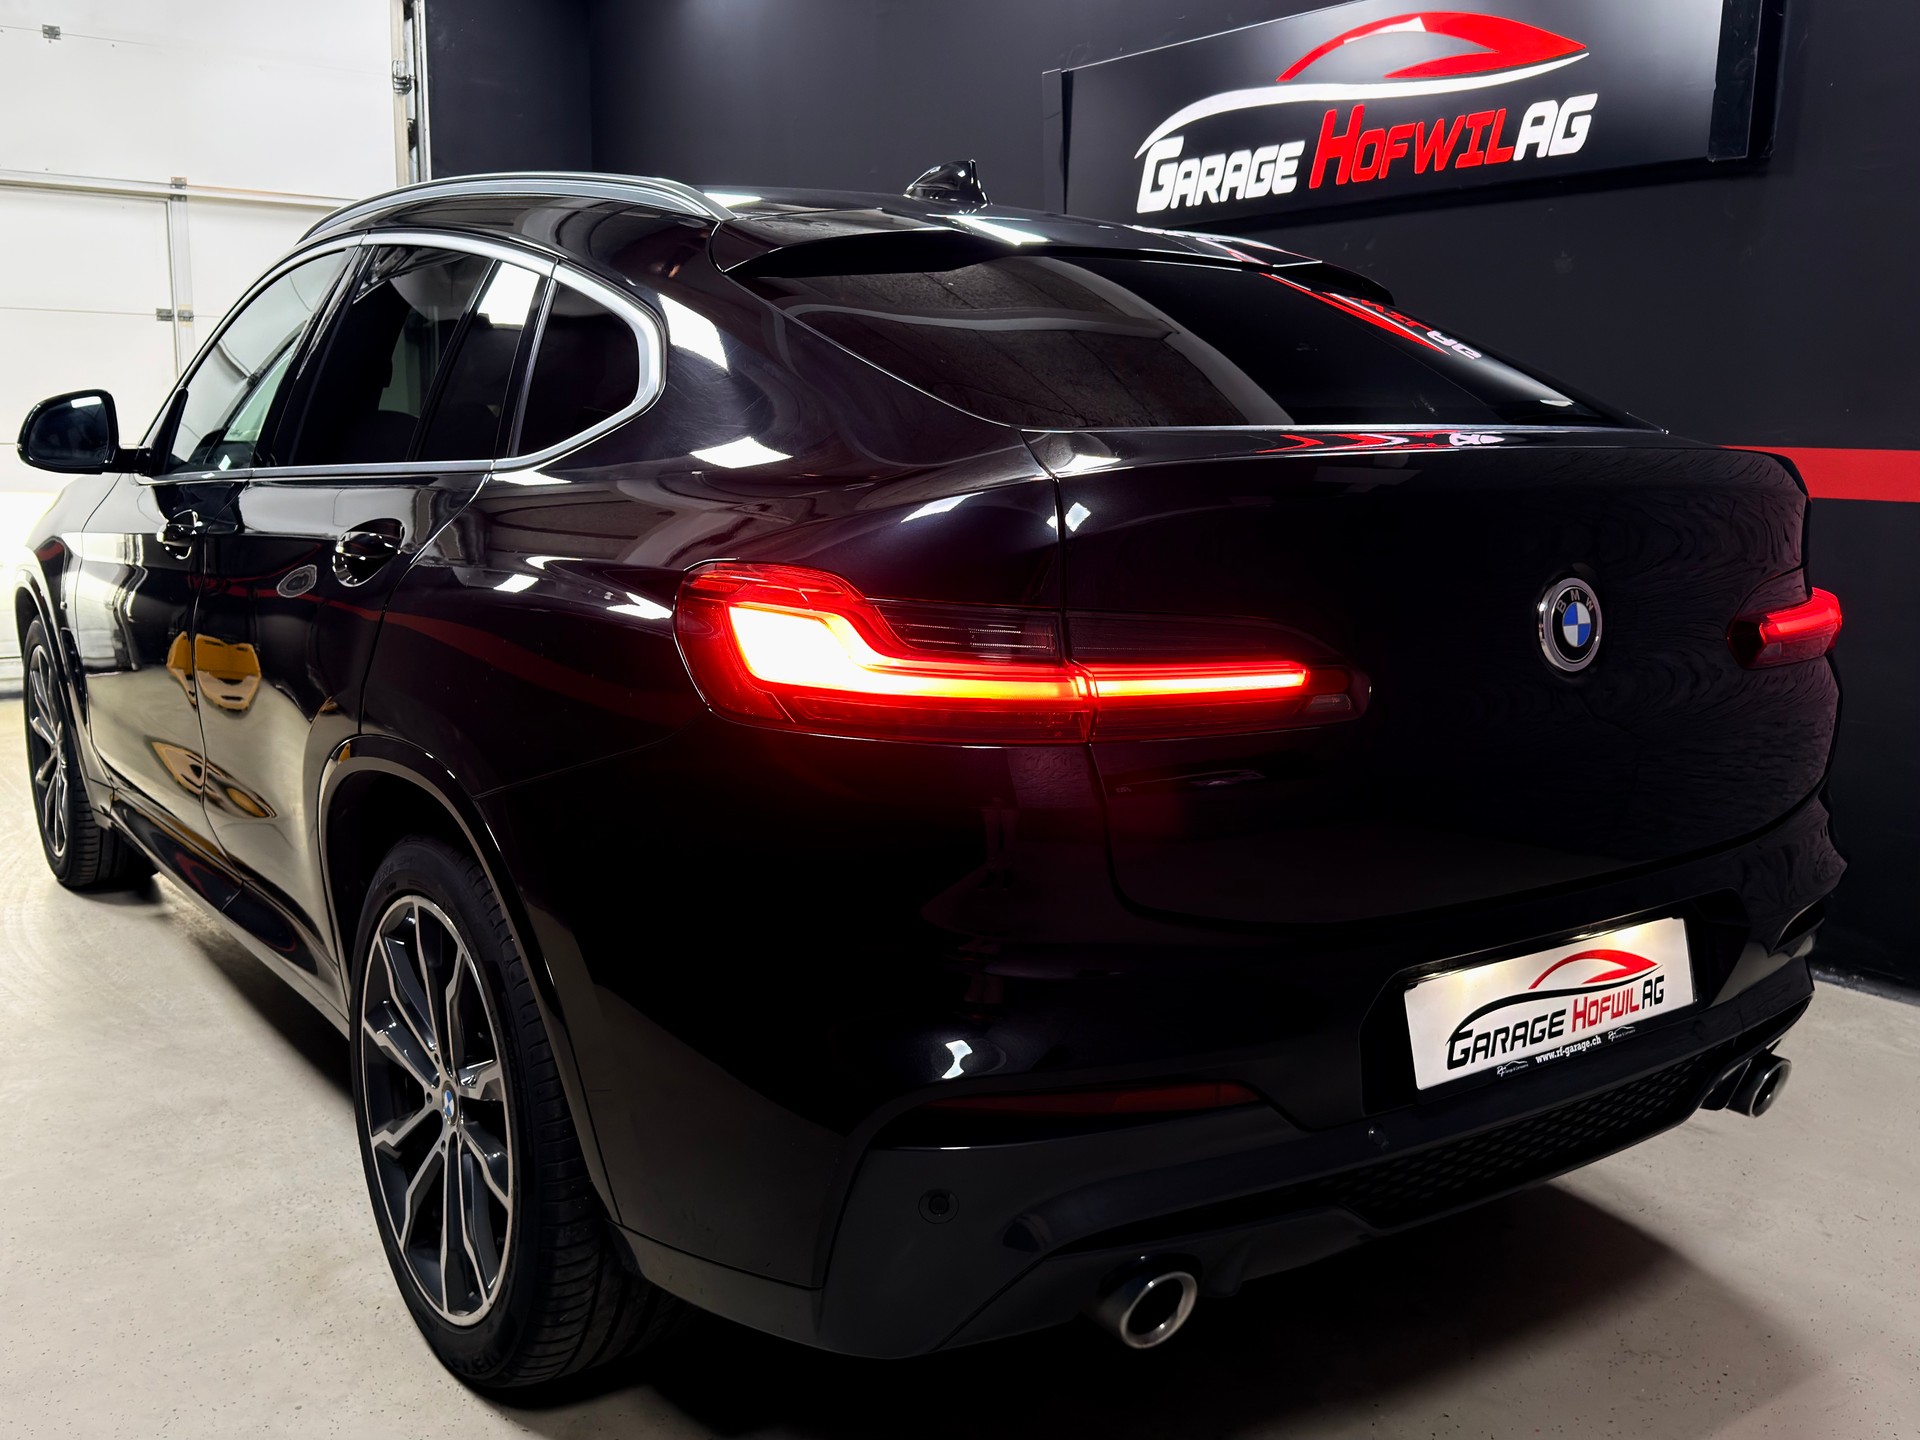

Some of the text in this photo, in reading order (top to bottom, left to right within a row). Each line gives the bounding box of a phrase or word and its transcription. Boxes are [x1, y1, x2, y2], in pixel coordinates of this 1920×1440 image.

[1136, 93, 1598, 213] GARAGE HOFWIL AG
[1556, 589, 1594, 614] BMW
[1447, 975, 1665, 1071] GARAGE HOFWIL AG
[1535, 1035, 1602, 1065] www.rf-garage.ch
